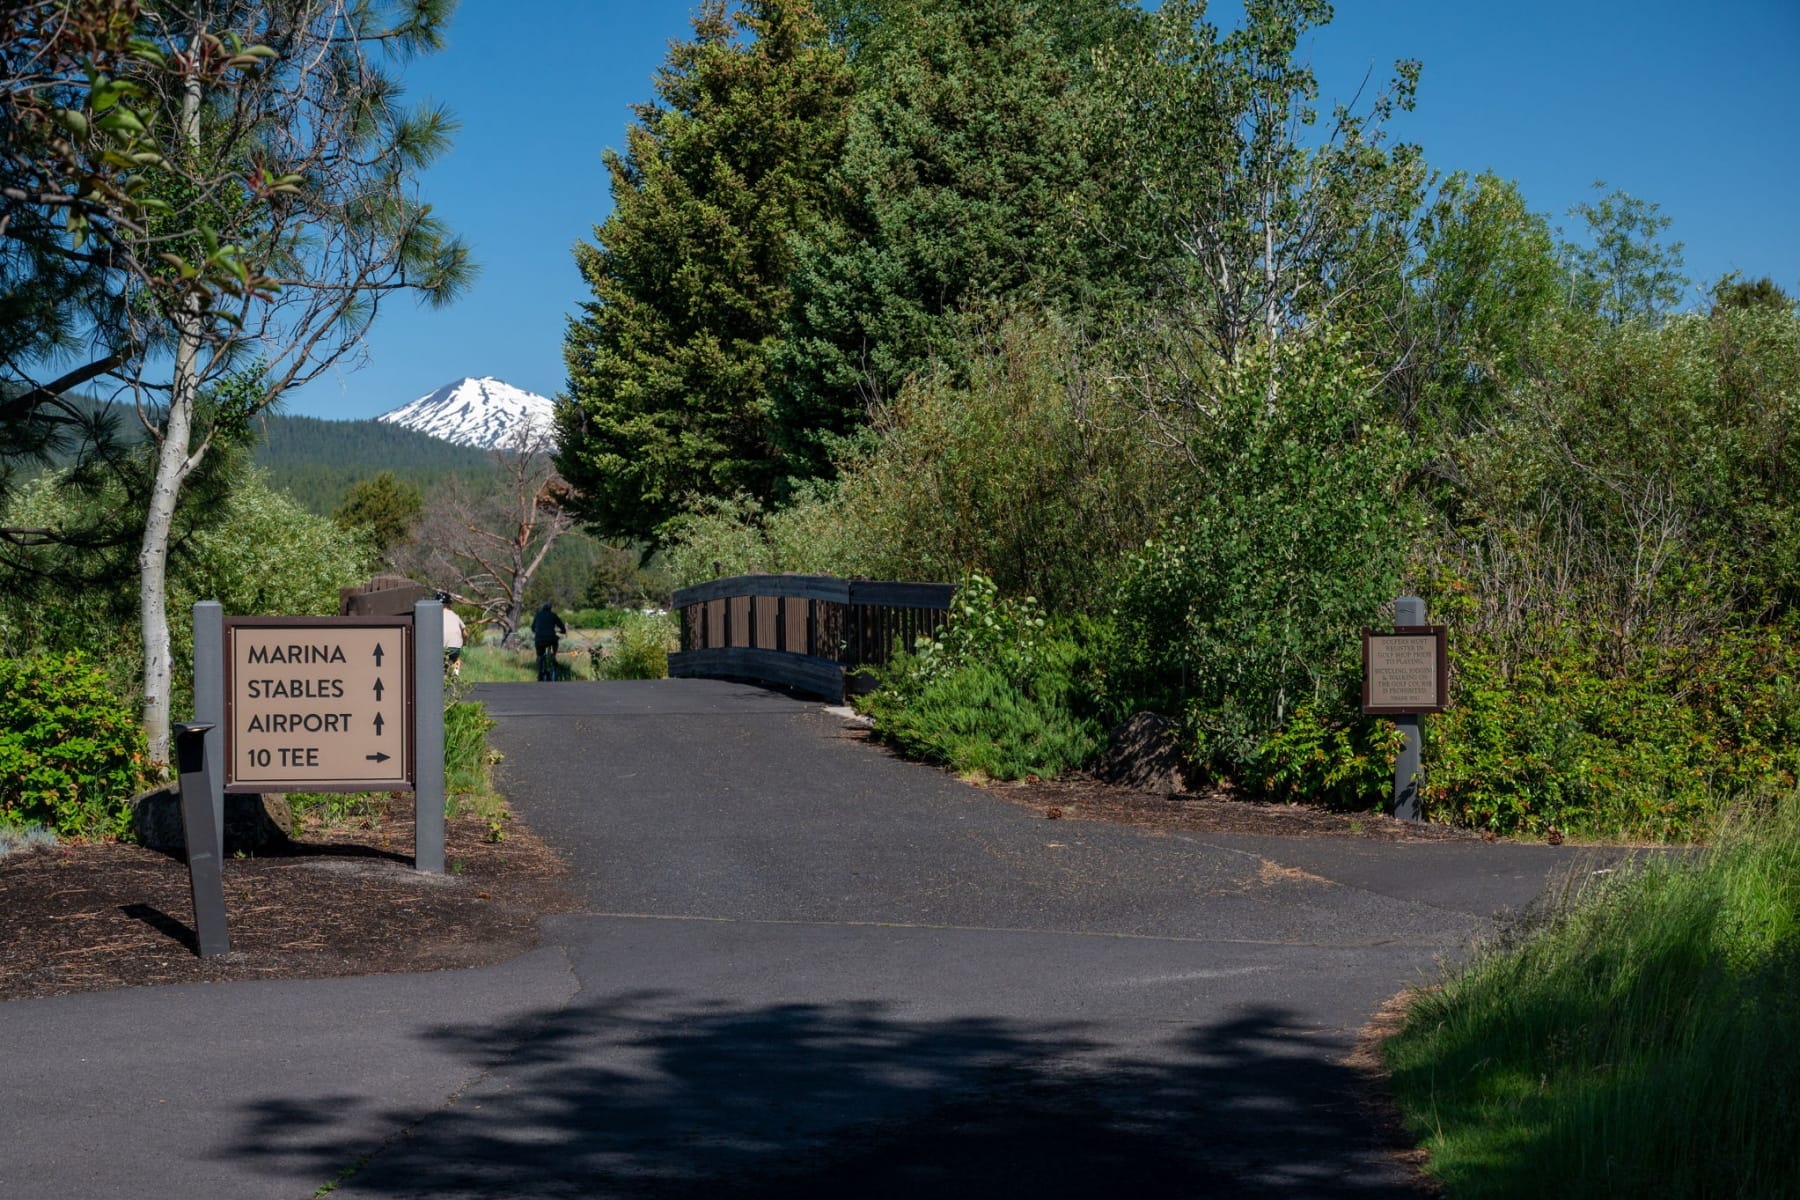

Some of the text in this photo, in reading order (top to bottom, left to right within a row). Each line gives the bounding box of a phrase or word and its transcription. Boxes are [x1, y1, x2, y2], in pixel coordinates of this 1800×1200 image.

[248, 645, 347, 664] MARINA
[248, 679, 344, 698] STABLES
[248, 713, 352, 733] AIRPORT
[248, 748, 319, 767] 10 TEE
